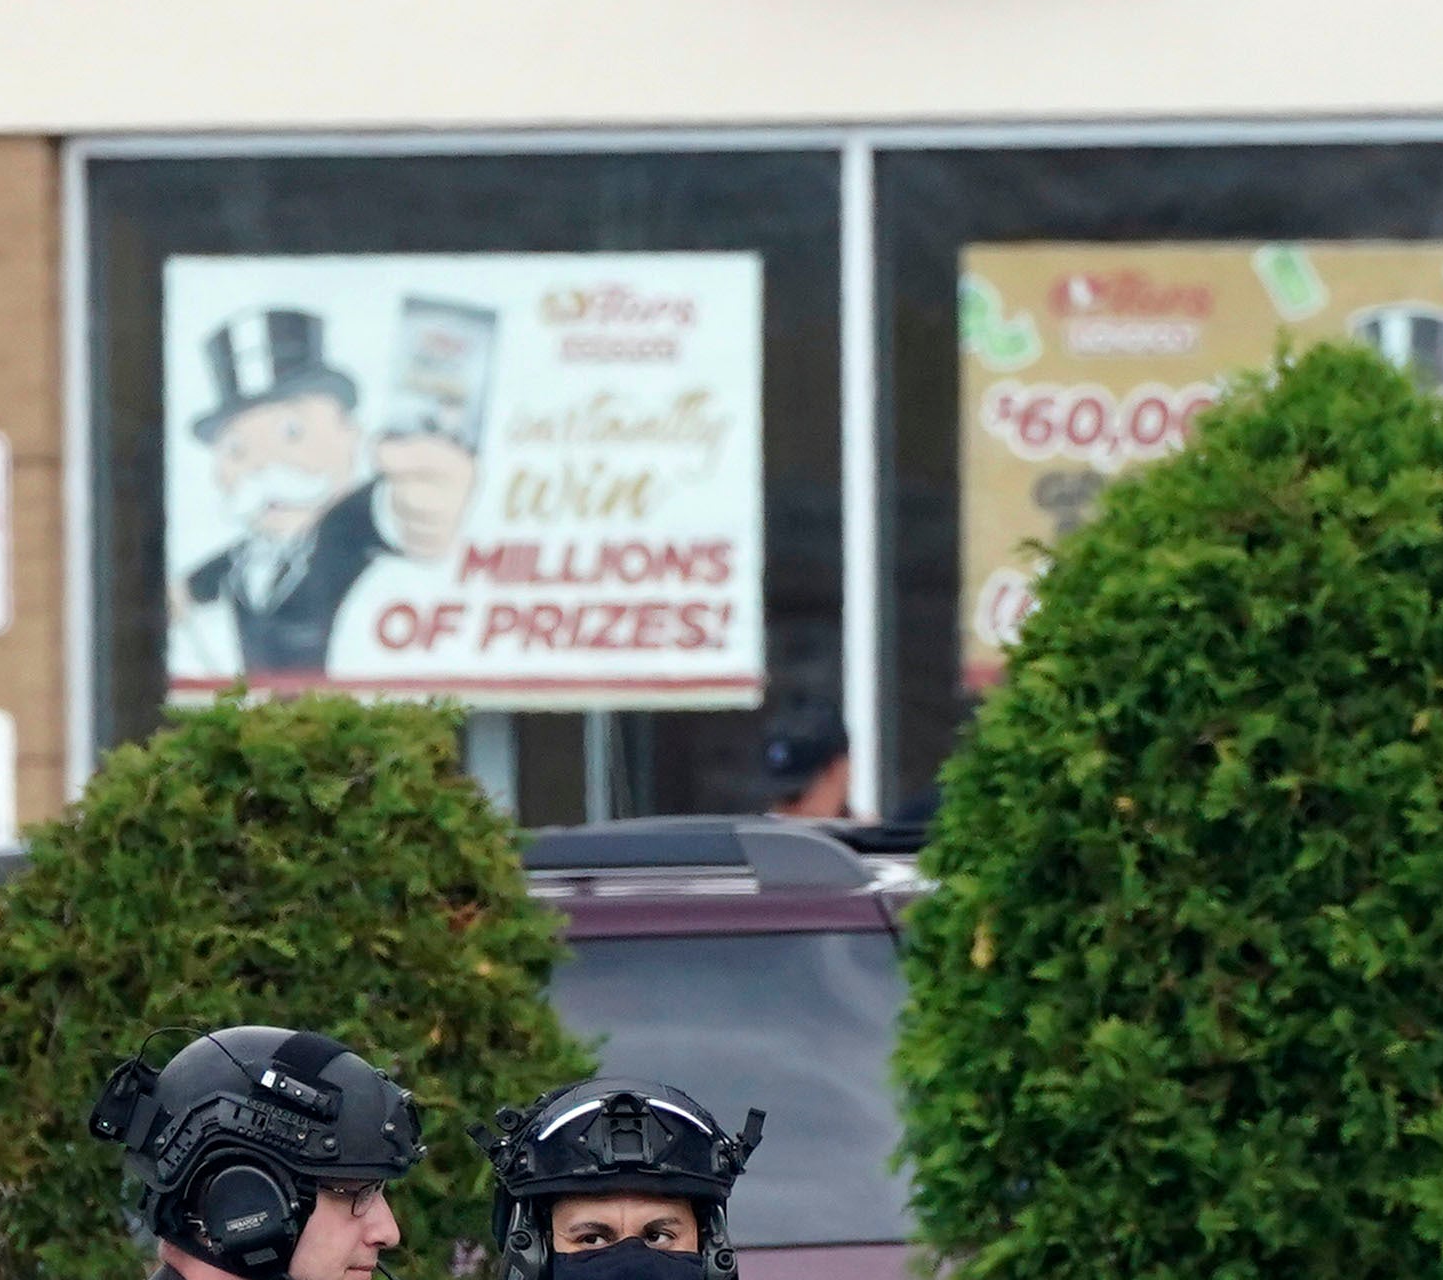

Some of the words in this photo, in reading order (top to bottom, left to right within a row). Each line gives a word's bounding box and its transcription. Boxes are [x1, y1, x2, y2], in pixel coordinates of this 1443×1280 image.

[459, 540, 734, 584] MILLIONS
[376, 601, 467, 651] OF
[477, 600, 734, 651] PRIZES!
